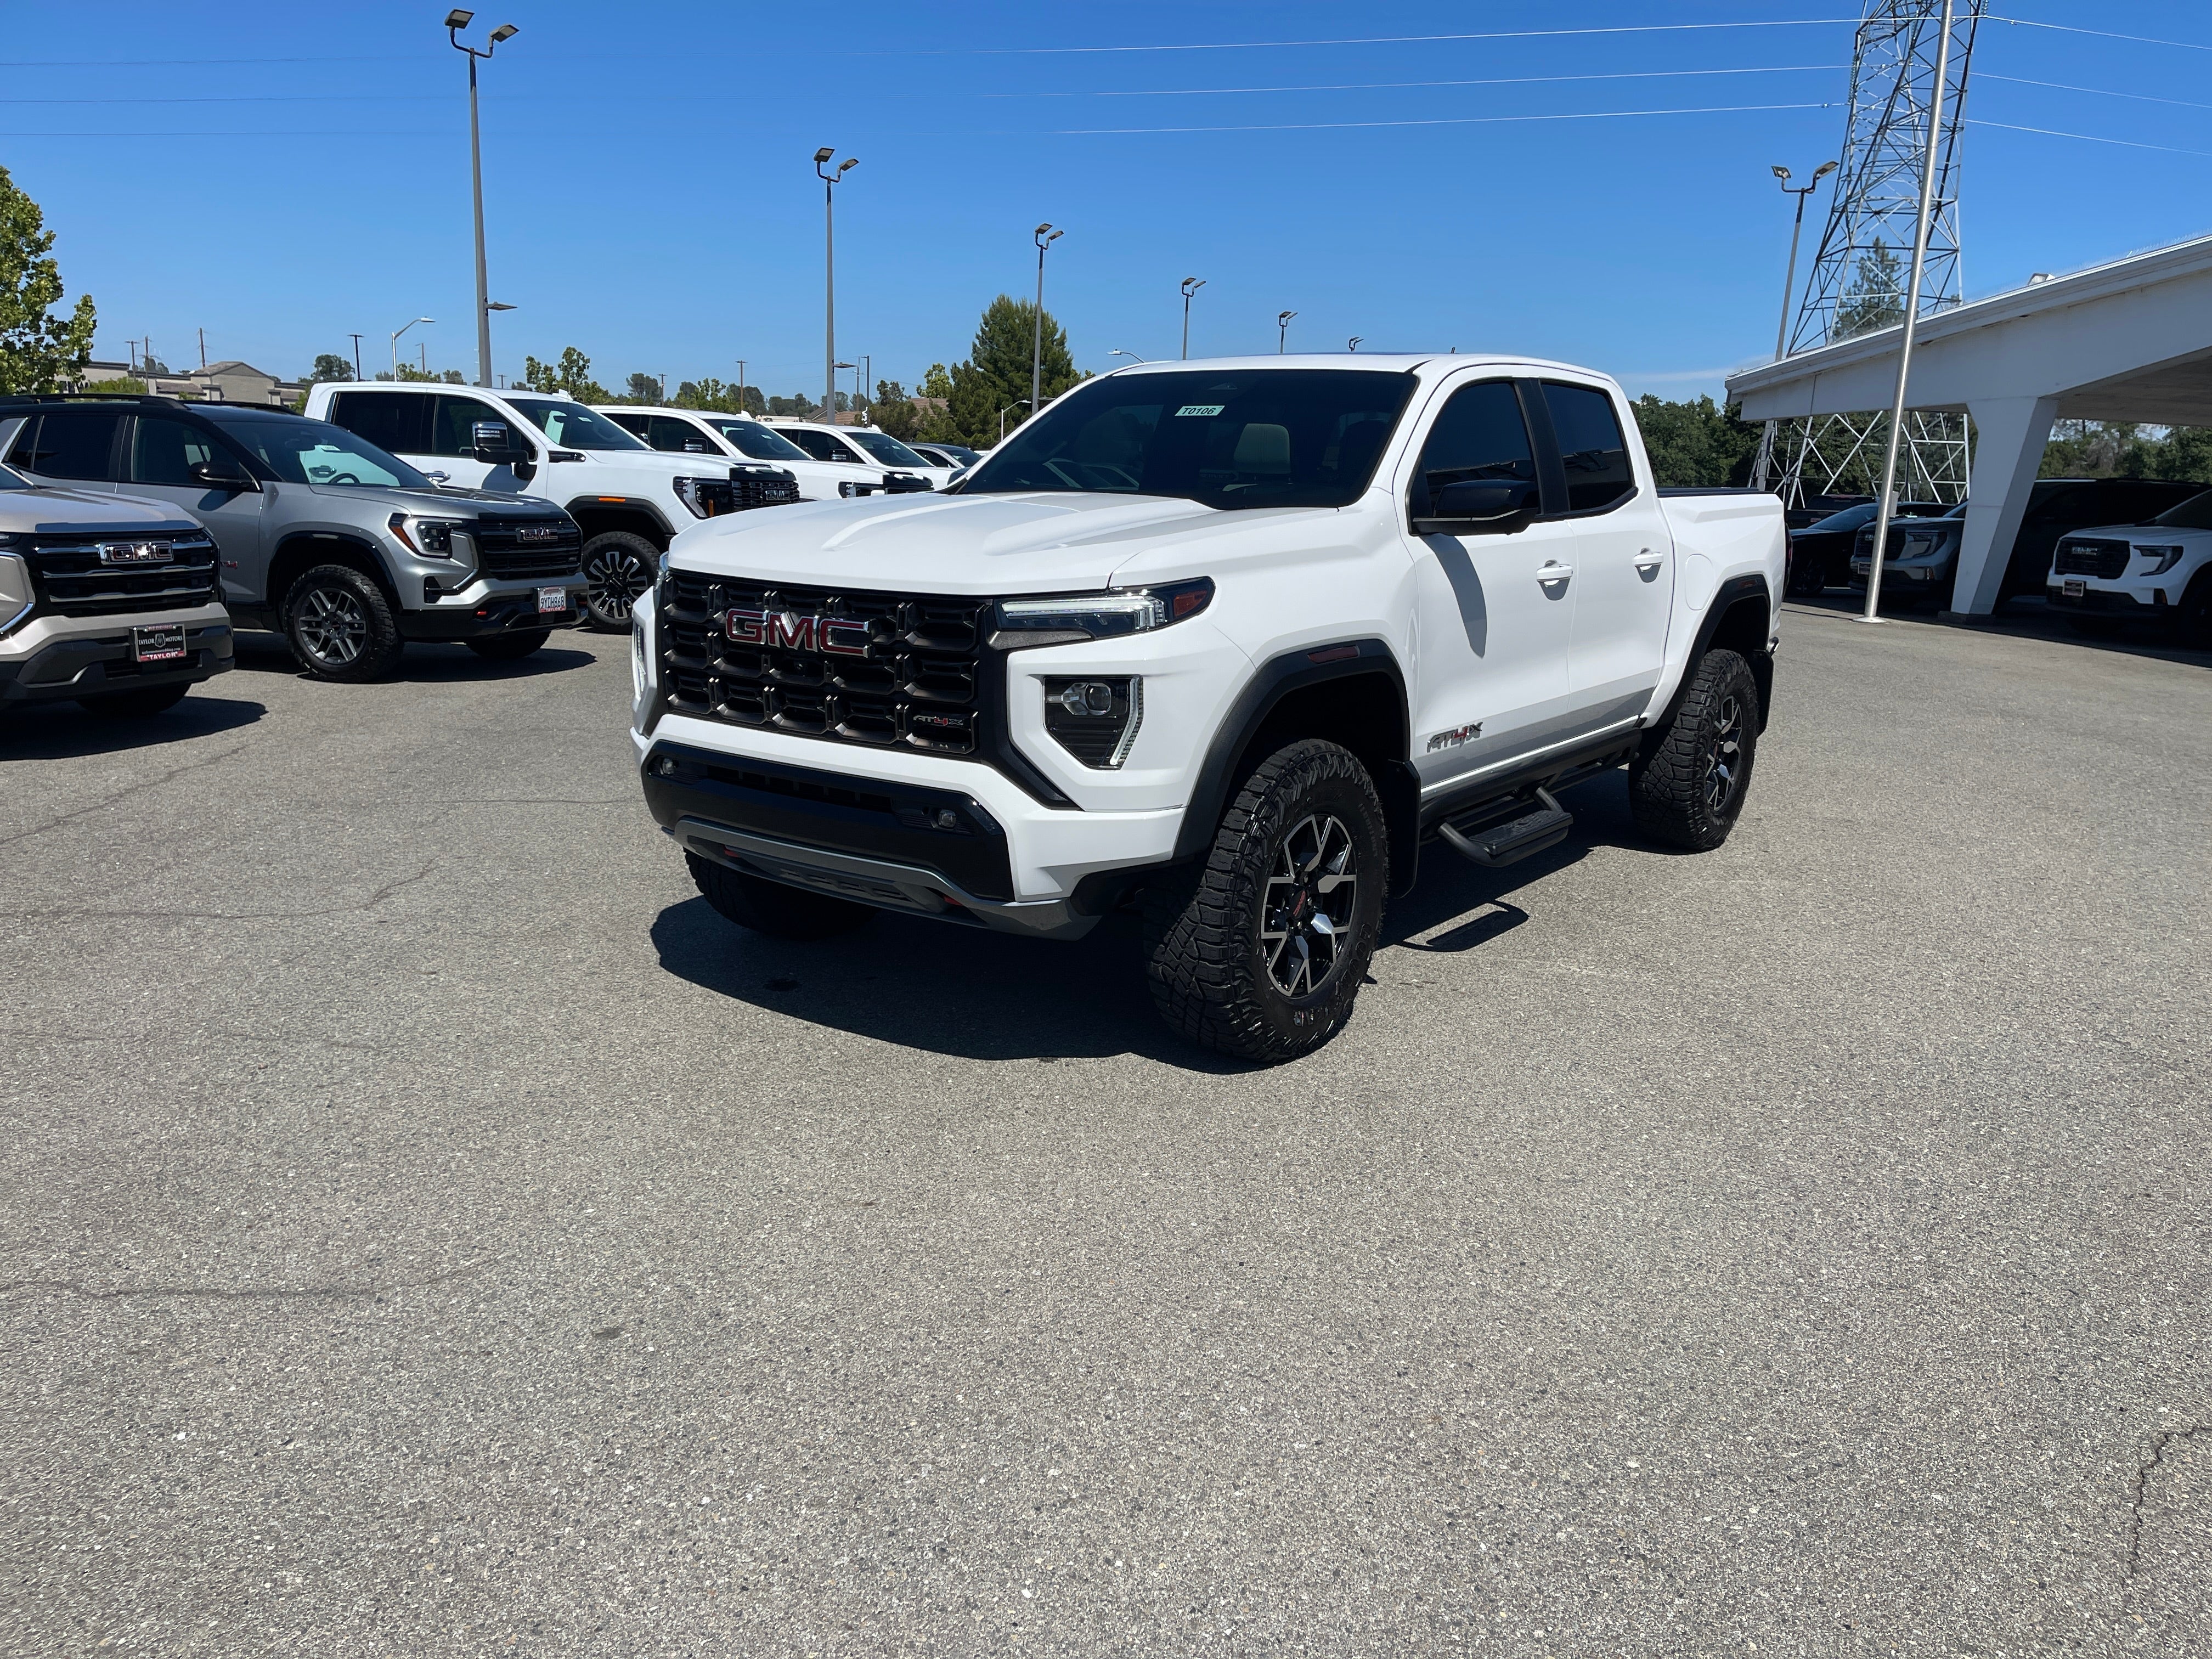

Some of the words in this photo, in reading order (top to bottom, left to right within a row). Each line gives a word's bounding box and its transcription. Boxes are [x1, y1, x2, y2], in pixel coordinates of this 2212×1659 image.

[1182, 407, 1216, 415] T0106
[520, 527, 558, 540] GMC
[106, 540, 174, 562] GMC
[725, 608, 868, 658] GMC
[913, 715, 964, 727] AT4X
[1426, 721, 1483, 749] AT4X
